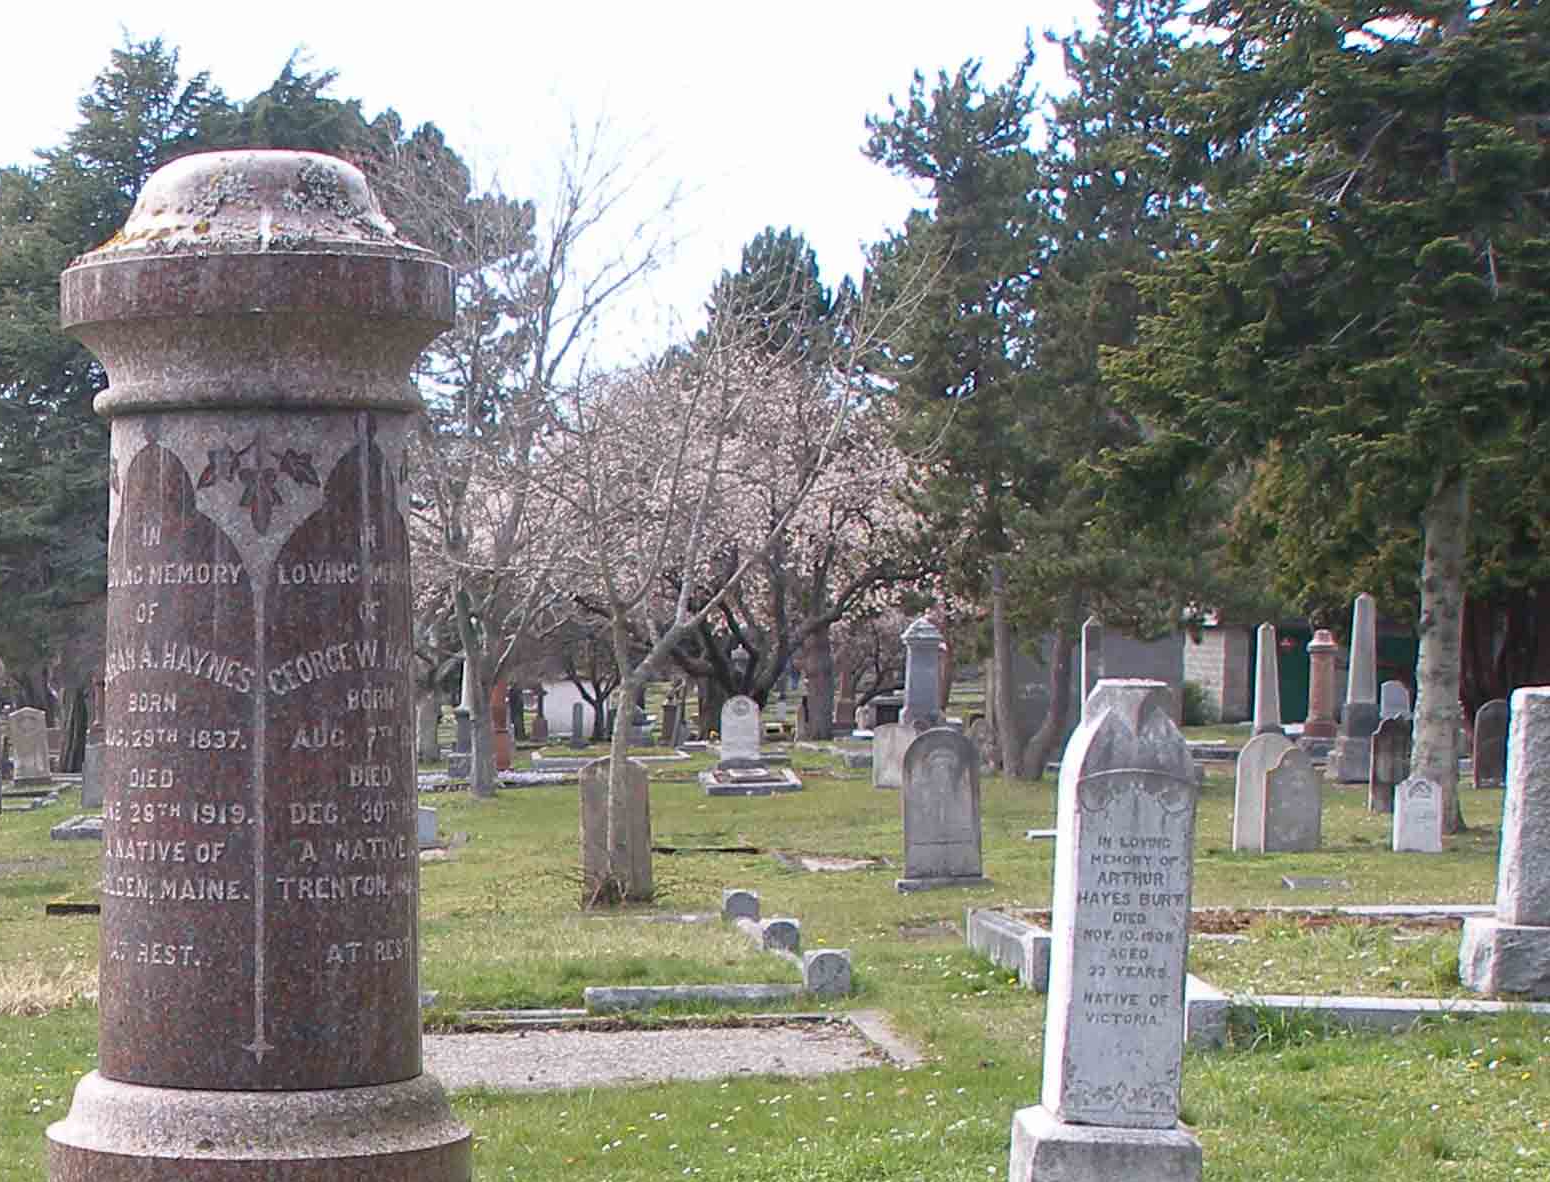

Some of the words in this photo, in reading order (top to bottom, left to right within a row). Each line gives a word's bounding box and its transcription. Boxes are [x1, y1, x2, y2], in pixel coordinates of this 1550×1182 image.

[141, 523, 162, 547] IN
[148, 561, 243, 585] MEMORY
[277, 560, 359, 585] LOVING
[136, 602, 161, 624] OF
[161, 640, 257, 693] HAYNES
[267, 642, 354, 696] GEORGE
[128, 691, 178, 713] BORN
[346, 687, 395, 711] BORN
[187, 727, 248, 750] 1837.
[129, 767, 173, 789] DIED
[347, 762, 392, 788] DIED
[193, 800, 257, 825] 1919.
[115, 838, 187, 862] NATIVE
[193, 840, 226, 864] OF
[300, 839, 318, 863] A
[335, 837, 407, 862] NATIVE
[1097, 836, 1112, 849] IN
[1119, 836, 1171, 849] LOVING
[1090, 854, 1152, 866] MEMORY
[1097, 871, 1164, 886] ARTHUR
[159, 879, 251, 901] MAINE.
[1076, 890, 1131, 906] HAYES
[1112, 911, 1147, 925] DIED
[324, 941, 363, 963] AT
[1108, 947, 1149, 960] AGED
[1082, 990, 1139, 1007] NATIVE
[1149, 993, 1170, 1008] OF
